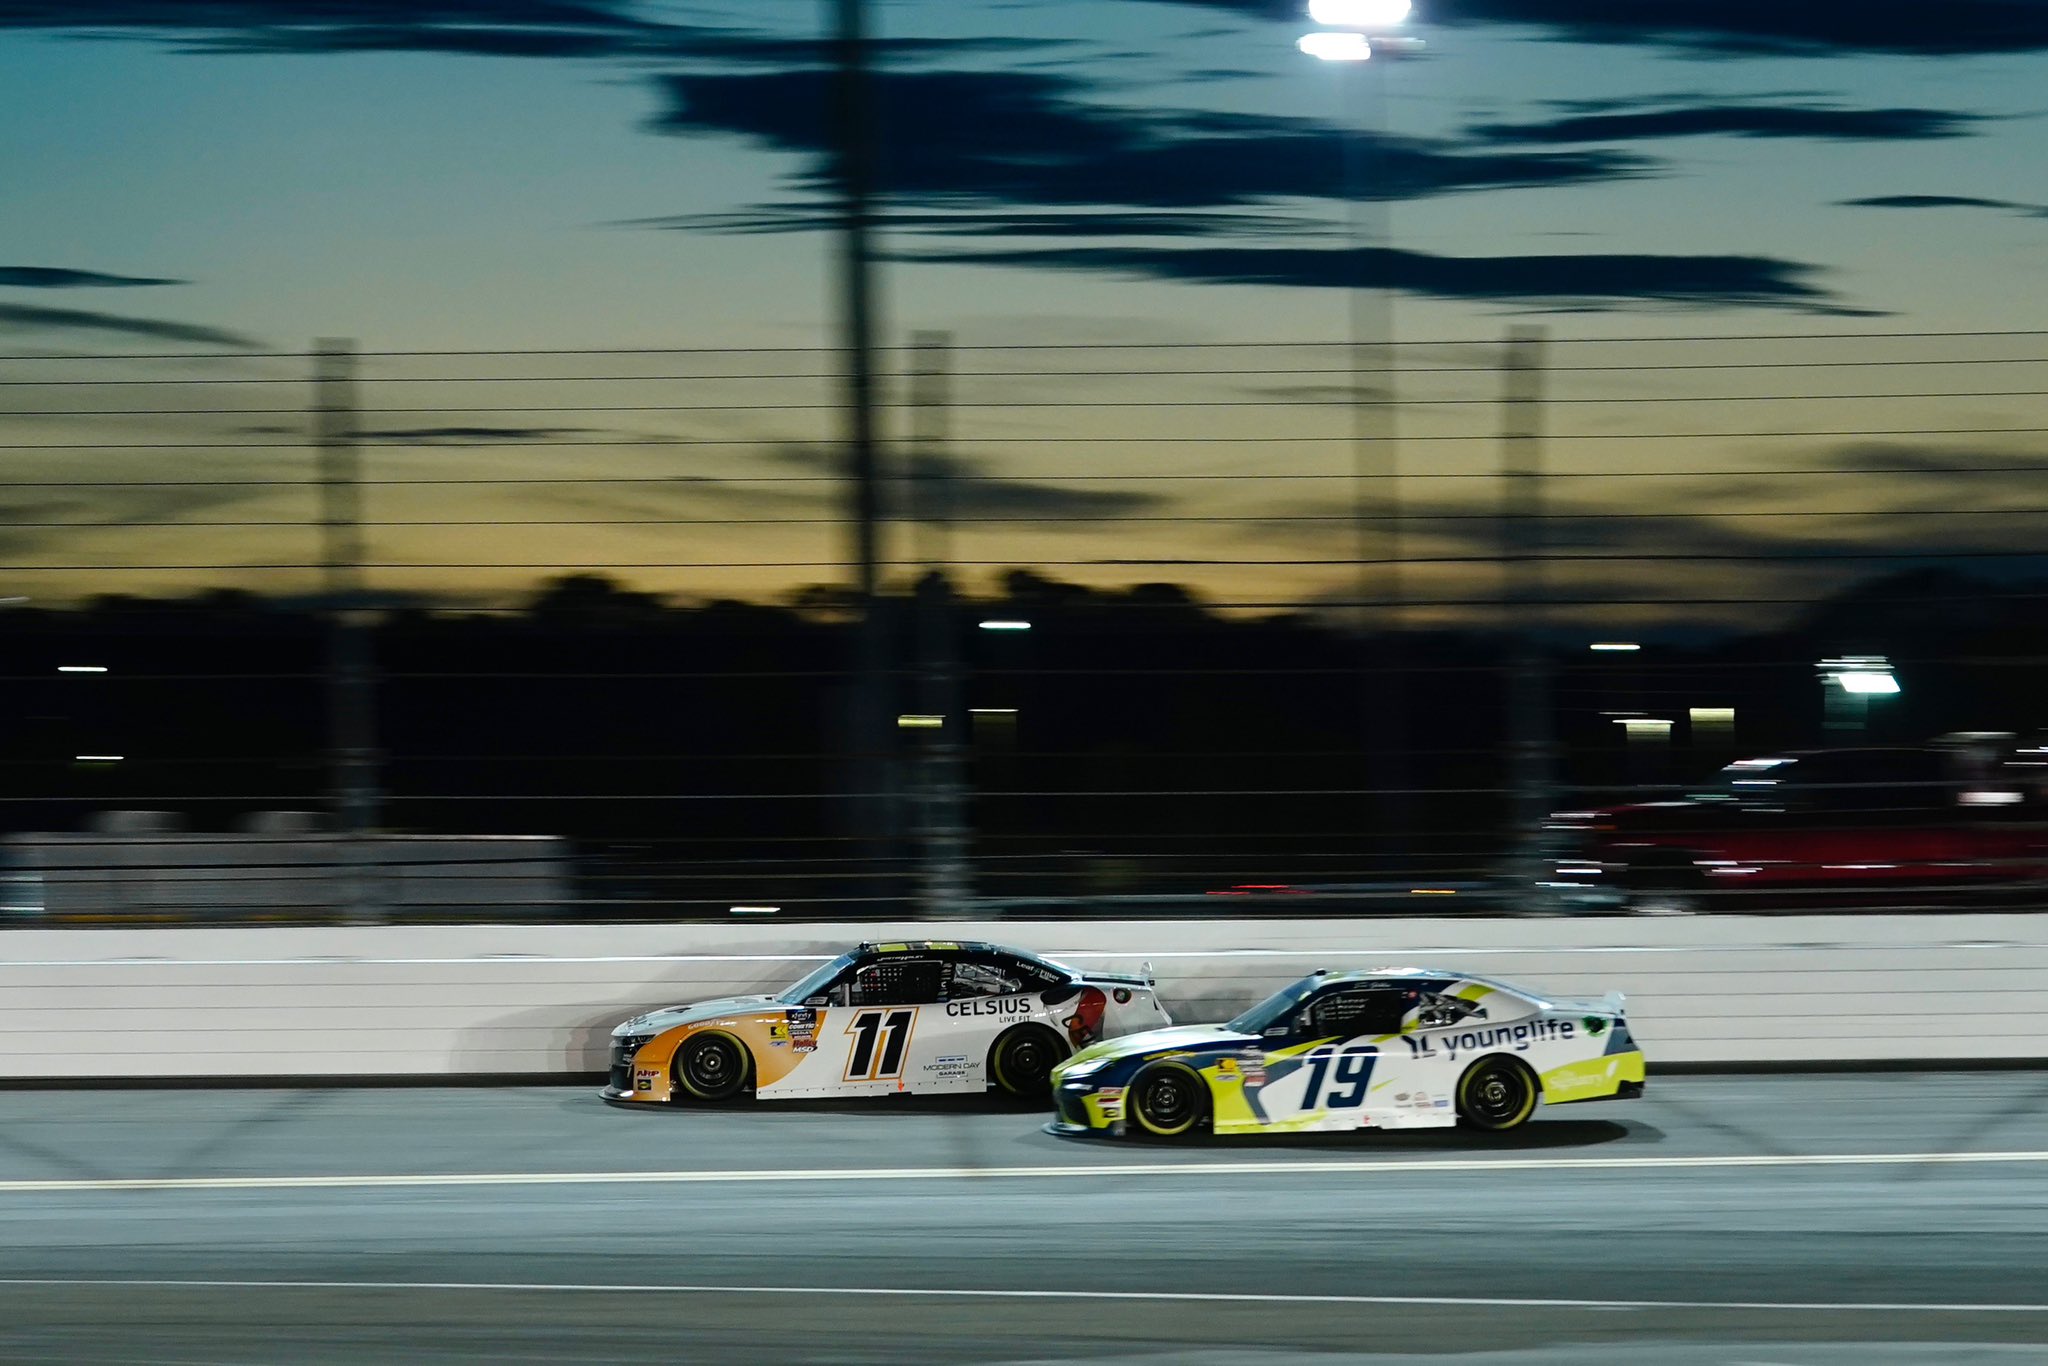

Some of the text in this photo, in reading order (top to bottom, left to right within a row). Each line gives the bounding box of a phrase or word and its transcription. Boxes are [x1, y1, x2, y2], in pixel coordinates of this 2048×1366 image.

[1016, 961, 1035, 971] Leaf
[946, 998, 1031, 1017] CELSIUS
[999, 1015, 1030, 1024] LIVE FIT
[850, 1011, 913, 1077] 11
[1441, 1021, 1575, 1061] younglife
[1300, 1045, 1379, 1110] 19
